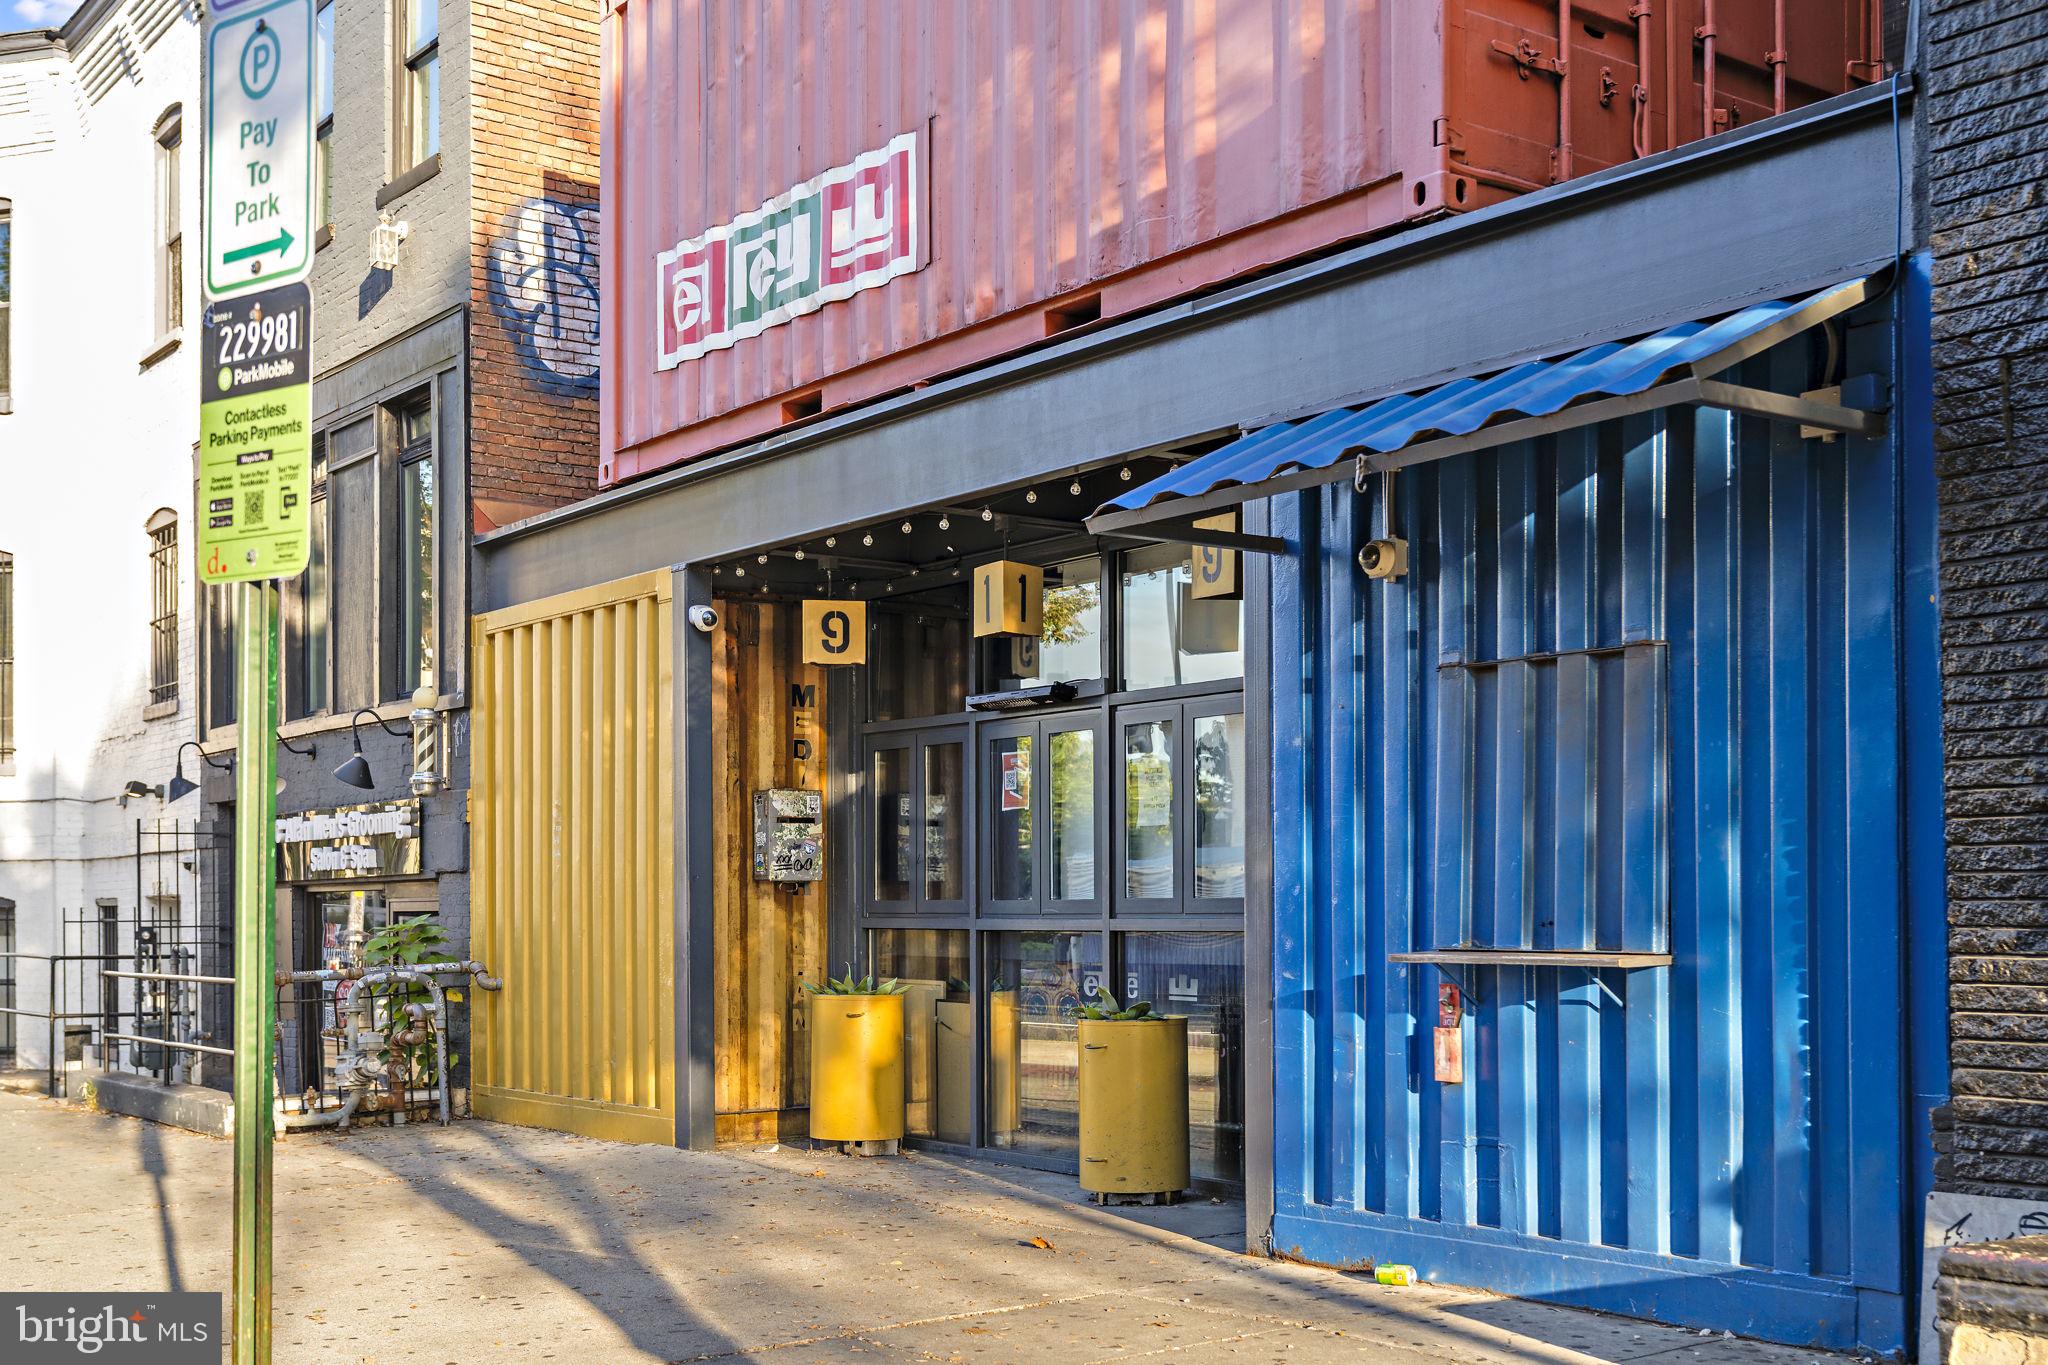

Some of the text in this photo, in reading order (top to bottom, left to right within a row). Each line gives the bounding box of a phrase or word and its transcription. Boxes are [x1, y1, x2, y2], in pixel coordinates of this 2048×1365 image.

[240, 118, 278, 149] Pay
[246, 160, 271, 187] To
[235, 192, 280, 227] Park
[733, 212, 811, 311] rey
[218, 310, 297, 364] 229981
[234, 359, 295, 386] ParkMobile
[224, 403, 287, 425] Contactless
[209, 420, 303, 447] Parking Payments
[984, 574, 991, 624] 1
[1018, 574, 1027, 623] 1
[821, 610, 850, 654] 9
[347, 805, 412, 840] Grooming
[310, 846, 341, 872] Salon
[350, 844, 378, 876] Spa
